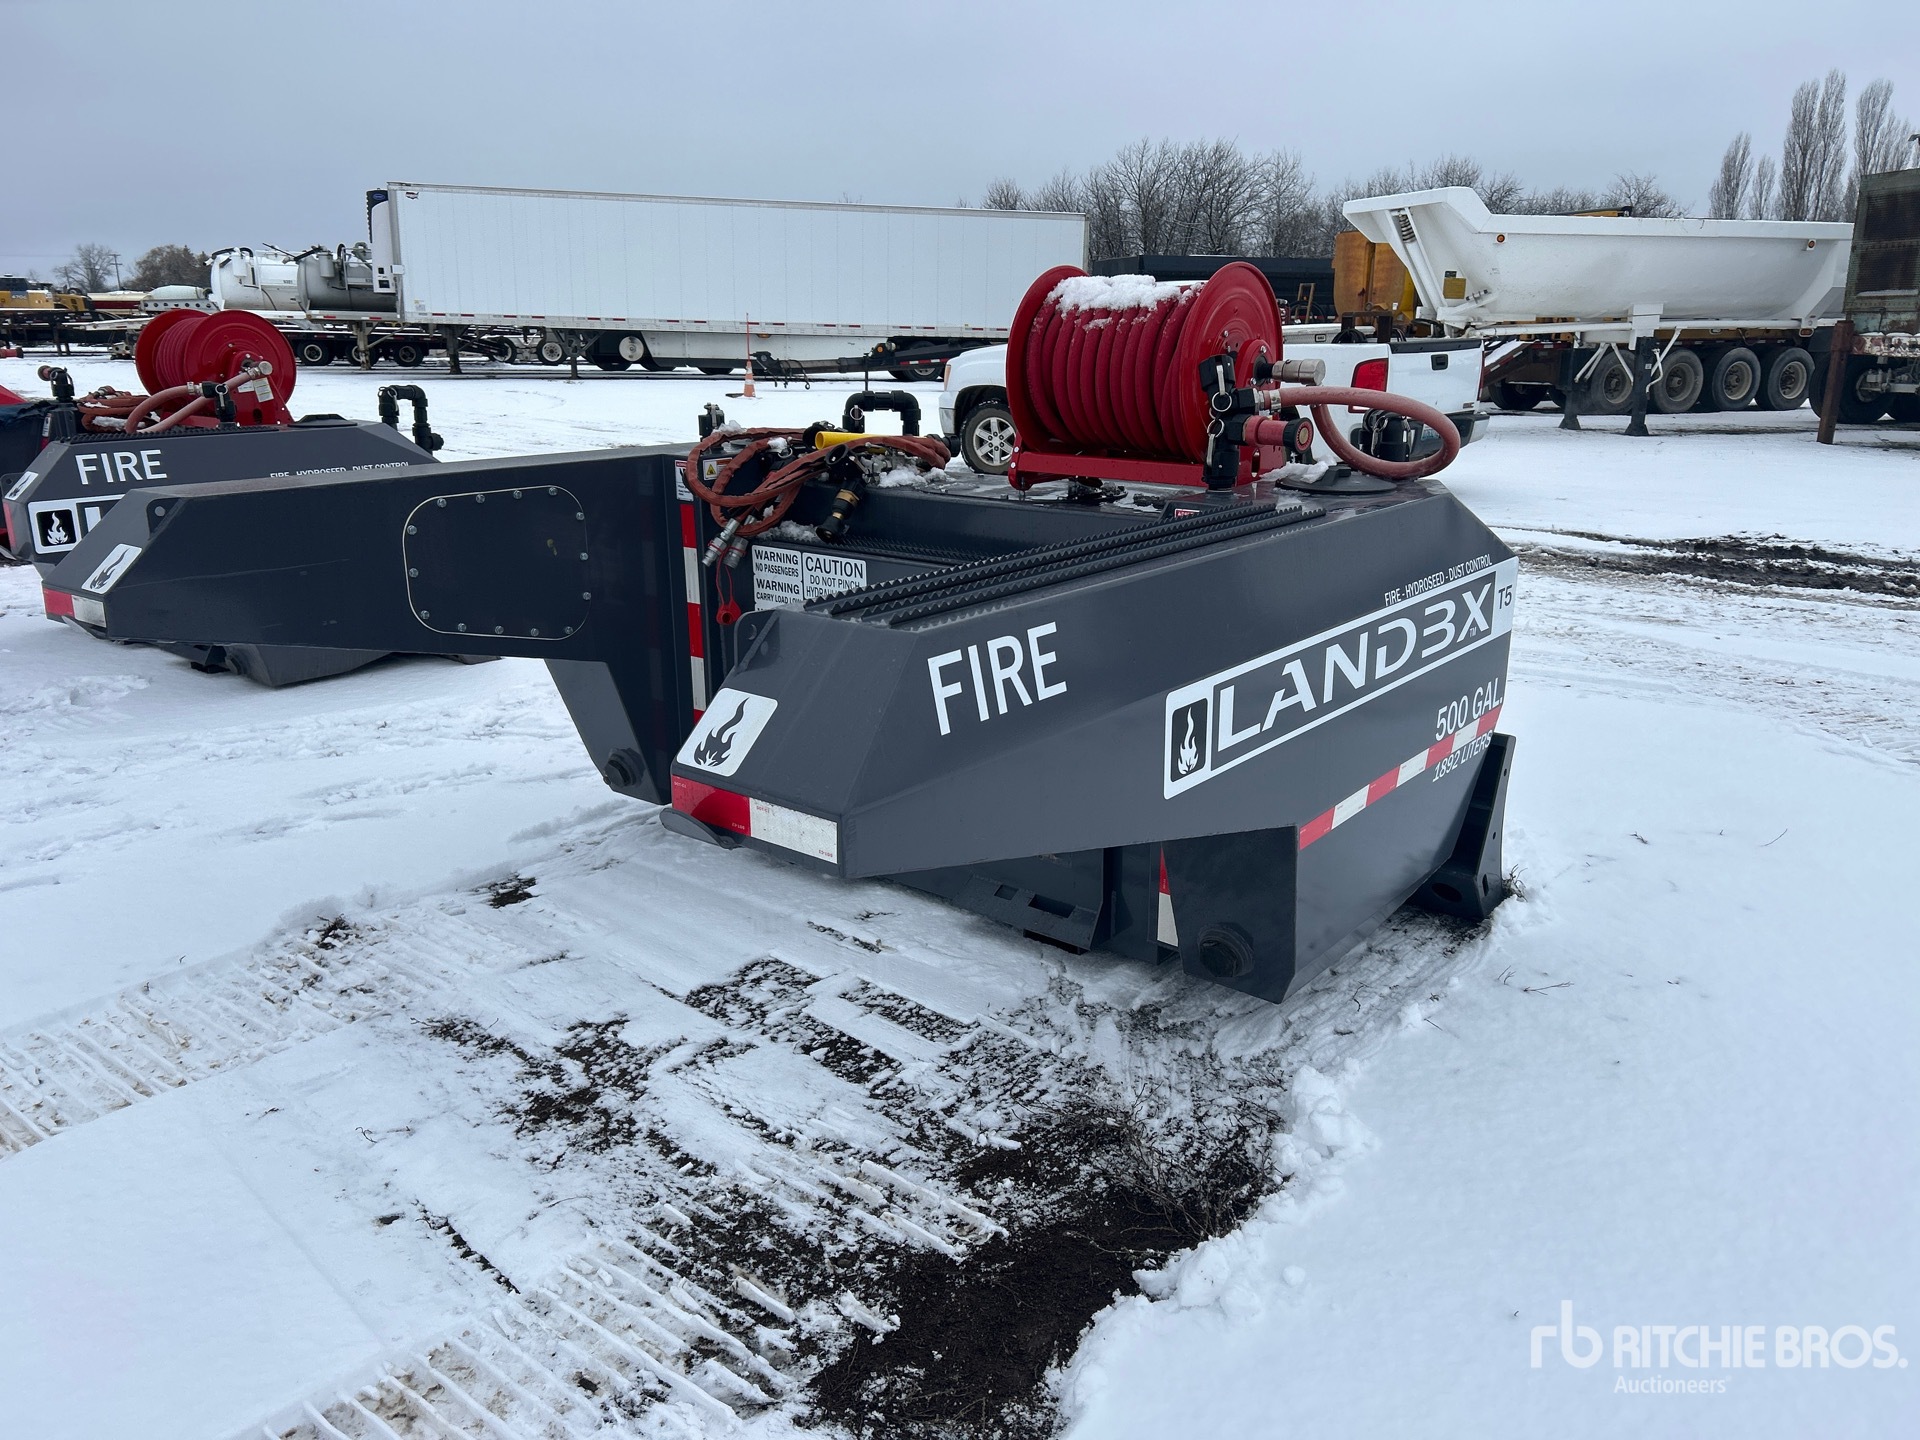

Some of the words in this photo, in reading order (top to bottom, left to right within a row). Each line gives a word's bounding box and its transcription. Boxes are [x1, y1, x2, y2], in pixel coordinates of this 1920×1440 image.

[75, 449, 167, 485] FIRE
[754, 549, 799, 565] WARNING
[805, 556, 863, 579] CAUTION
[755, 562, 764, 571] NO
[763, 563, 799, 577] PASSENGERS
[809, 574, 821, 586] DO
[821, 577, 836, 588] NOT
[1384, 588, 1402, 606] FIRE
[1405, 571, 1445, 598] HYDROSEED
[1448, 563, 1465, 581] DUST
[1465, 554, 1493, 574] CONTROL
[756, 578, 800, 594] WARNING
[756, 591, 774, 602] CARRY
[1498, 585, 1513, 609] T5
[927, 621, 1068, 737] FIRE
[1435, 695, 1469, 741] 500
[1472, 677, 1503, 720] GAL.
[1432, 750, 1461, 783] 1892
[1460, 729, 1493, 765] LITERS
